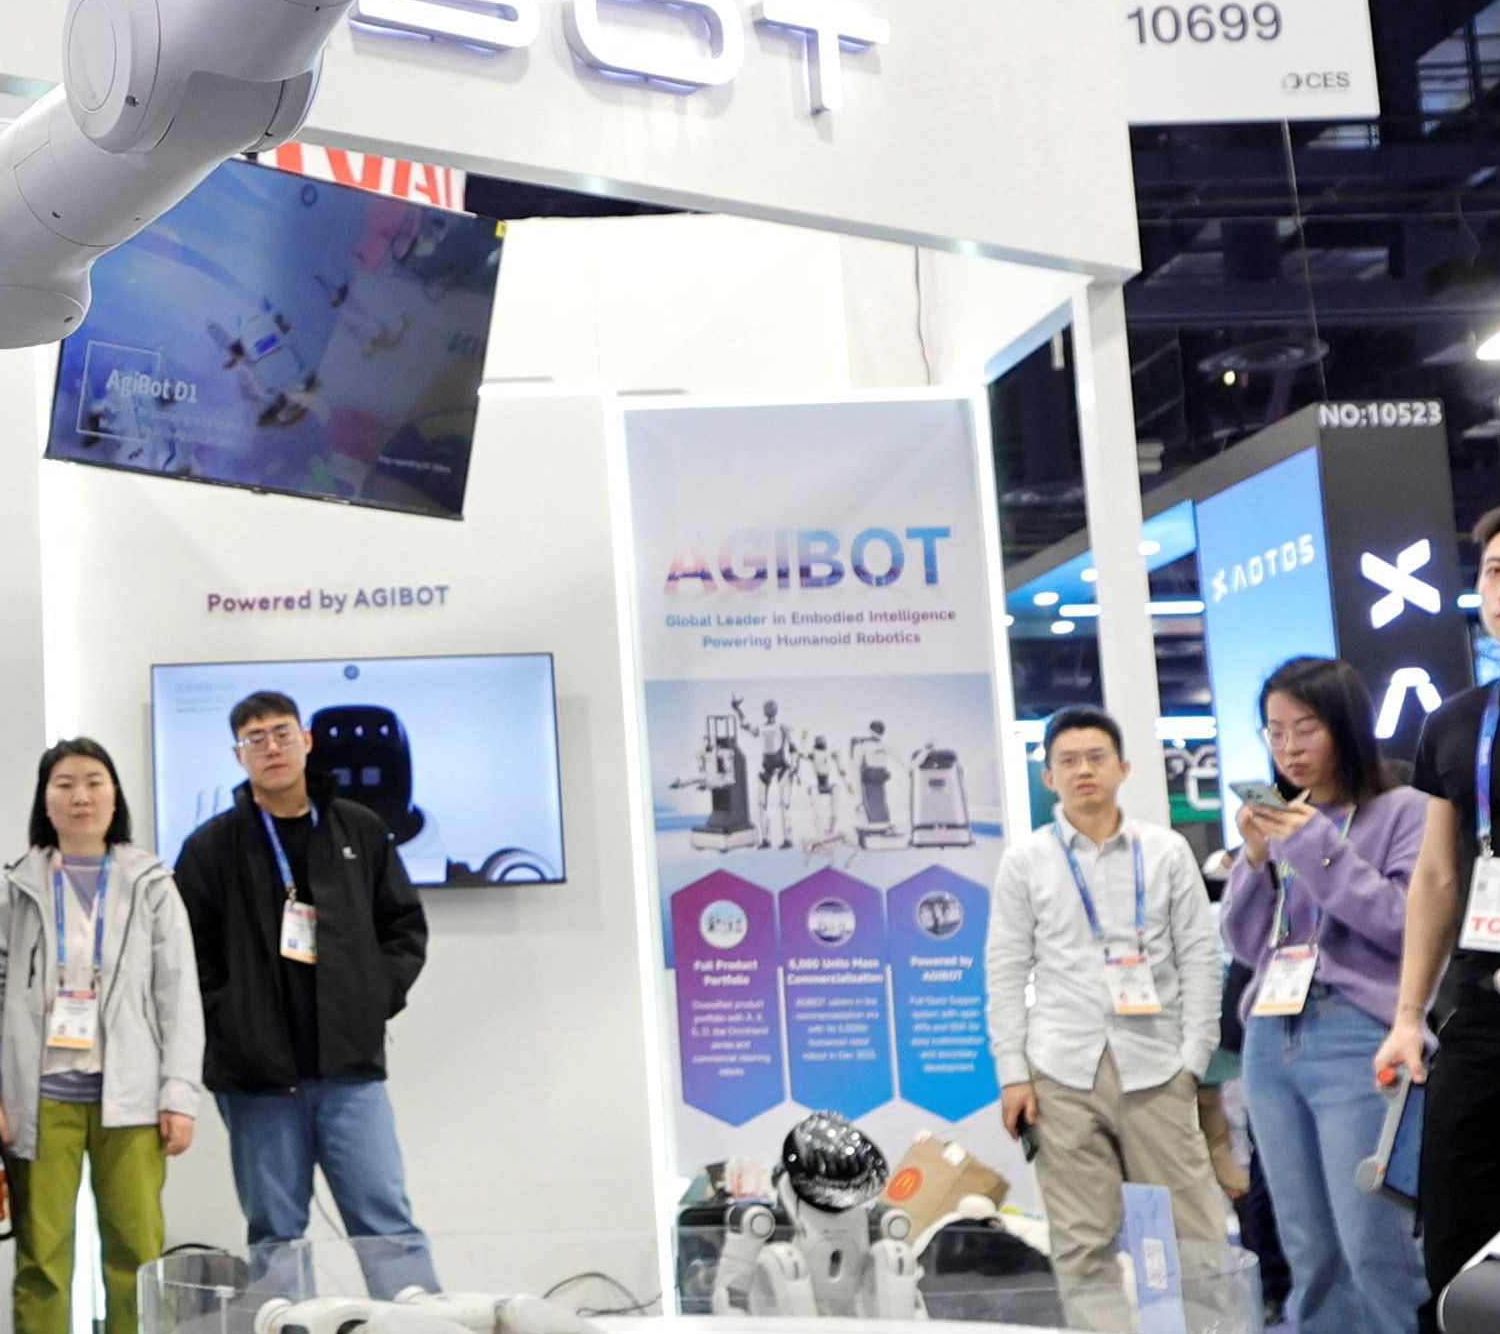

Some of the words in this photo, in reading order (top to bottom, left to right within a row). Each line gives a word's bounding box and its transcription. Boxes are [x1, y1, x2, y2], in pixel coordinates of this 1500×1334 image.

[1126, 0, 1284, 46] 10699
[1305, 72, 1351, 89] CES
[1318, 400, 1445, 430] NO:10523
[663, 525, 953, 595] AGIBOT
[206, 588, 312, 613] Powered
[319, 590, 347, 614] by
[353, 584, 450, 608] AGIBOT
[665, 613, 712, 628] Global
[716, 613, 767, 627] Leader
[772, 611, 787, 625] in
[790, 609, 864, 624] Embodied
[868, 607, 957, 624] Intelligence
[702, 634, 773, 649] Powering
[776, 632, 851, 646] Humanoid
[856, 630, 922, 645] Robotics
